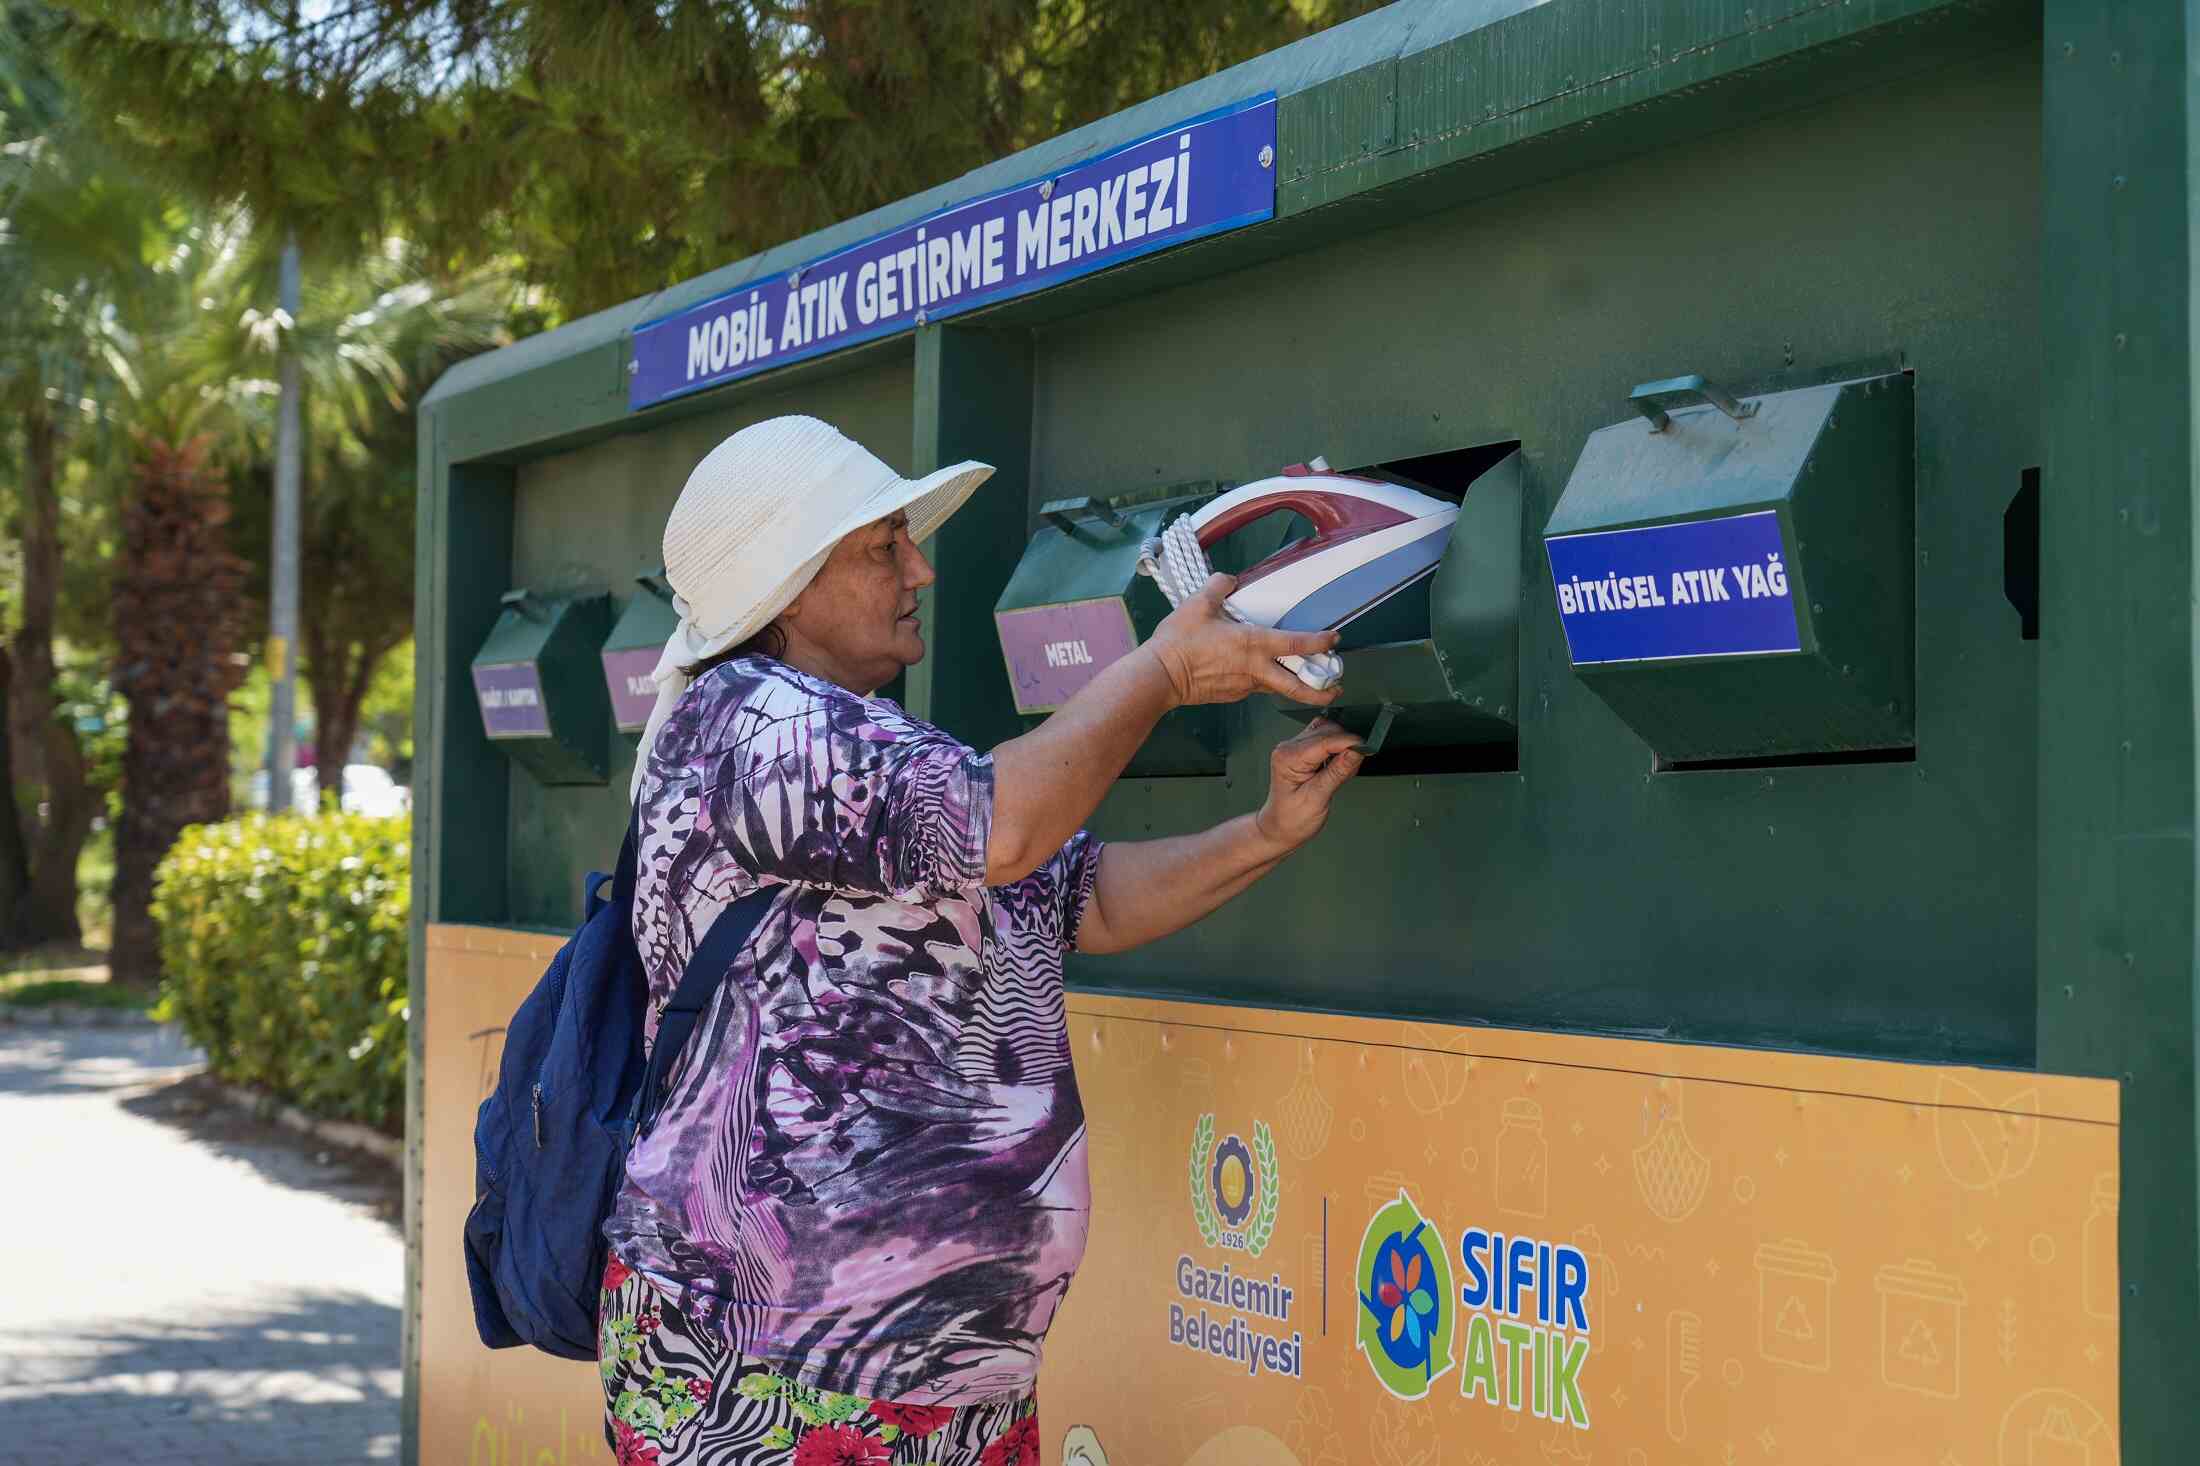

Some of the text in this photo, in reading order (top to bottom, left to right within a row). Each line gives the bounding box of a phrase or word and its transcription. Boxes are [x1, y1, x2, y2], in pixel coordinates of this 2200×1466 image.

[686, 133, 1191, 381] MOBİL ATIK GETİRME MERKEZİ
[1558, 552, 1789, 615] BİTKİSEL ATIK YAĞ
[1044, 640, 1093, 668] METAL
[1220, 1231, 1246, 1250] 1926
[1175, 1256, 1294, 1321] Gaziemir
[1461, 1227, 1591, 1334] SIFIR
[1168, 1303, 1302, 1378] Belediyesi
[1460, 1314, 1591, 1429] ATIK
